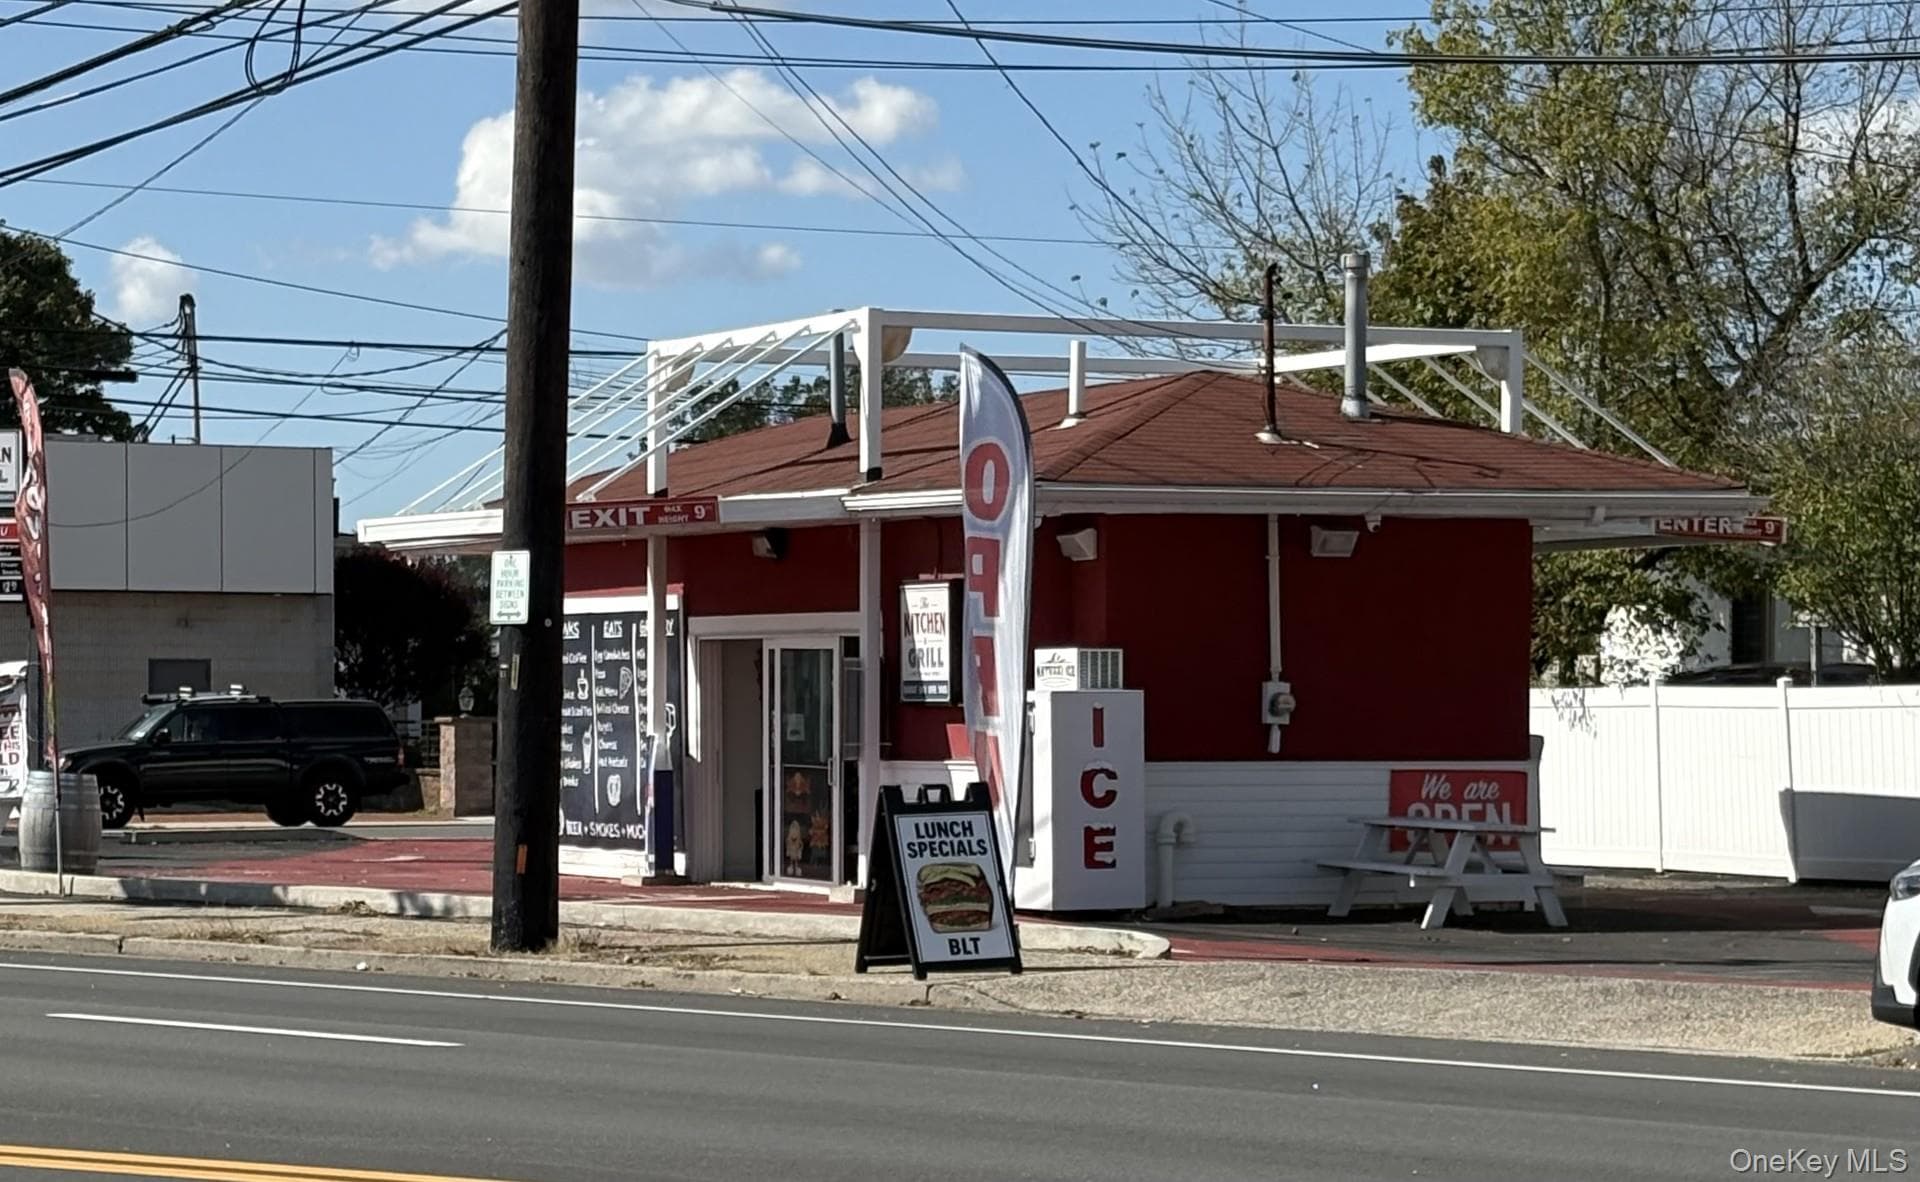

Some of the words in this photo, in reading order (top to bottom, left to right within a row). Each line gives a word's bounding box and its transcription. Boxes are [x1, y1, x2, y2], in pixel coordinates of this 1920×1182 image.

[572, 507, 650, 529] EXIT
[1659, 517, 1733, 534] ENTER
[603, 620, 623, 637] EATS
[904, 612, 946, 637] KITCHEN
[908, 647, 944, 669] GRILL
[1080, 705, 1118, 868] ICE
[1421, 773, 1451, 800] We
[1464, 779, 1500, 800] are
[589, 821, 621, 838] SMOKES
[914, 820, 975, 839] LUNCH
[907, 839, 988, 859] SPECIALS
[948, 937, 980, 956] BLT
